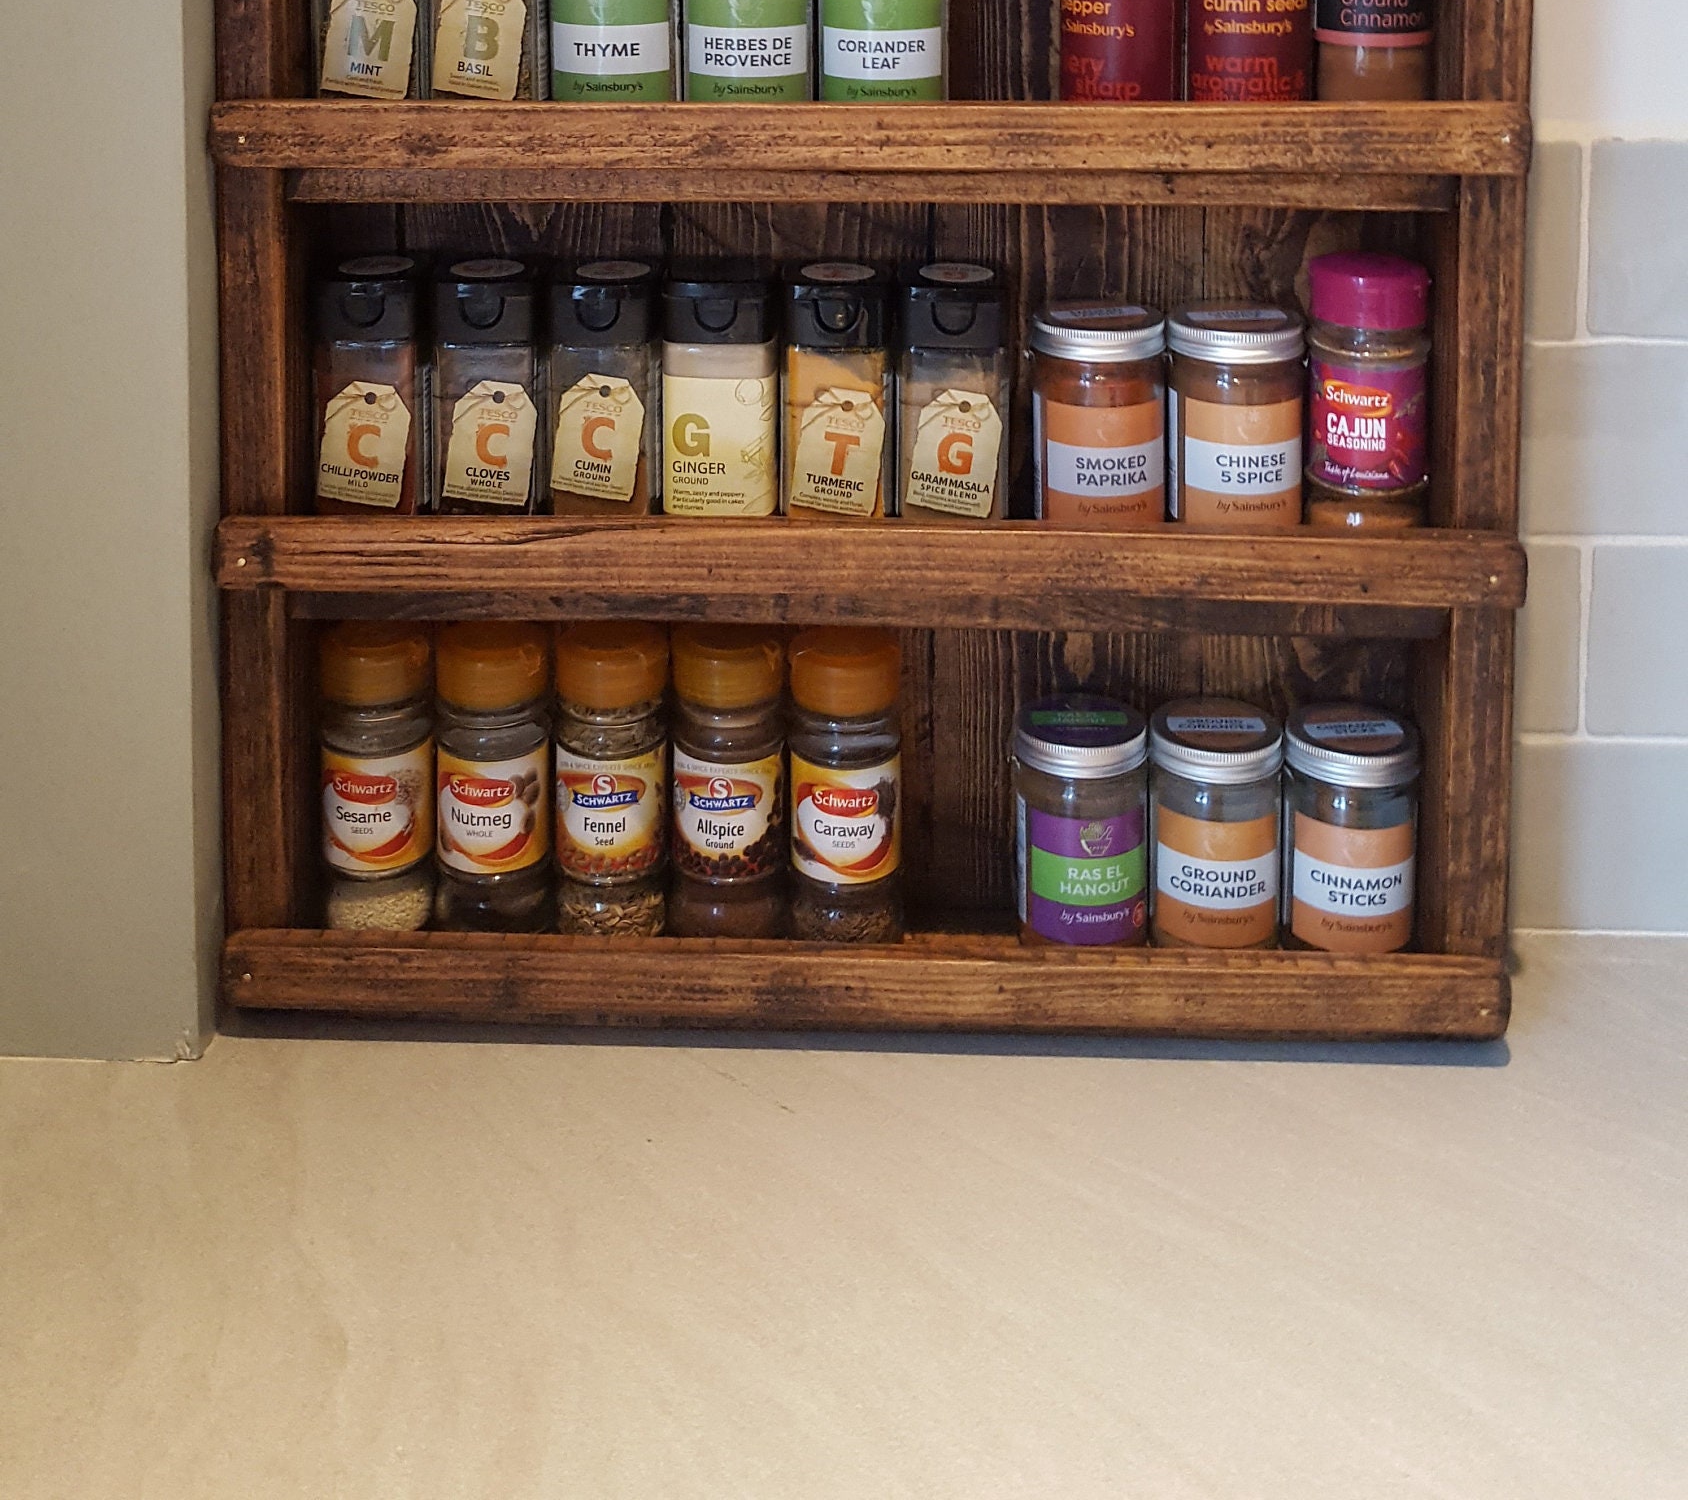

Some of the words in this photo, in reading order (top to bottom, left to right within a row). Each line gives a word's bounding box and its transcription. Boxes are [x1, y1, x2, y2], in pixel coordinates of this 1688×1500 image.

[355, 0, 395, 13] TESCO
[466, 0, 506, 13] TESCO
[1066, 19, 1135, 40] Sainsbury's
[1214, 19, 1293, 37] Sainsbury's
[347, 15, 395, 62] M
[464, 15, 499, 61] B
[704, 37, 767, 51] HERBES
[773, 37, 792, 50] DE
[837, 39, 926, 53] CORIANDER
[573, 42, 640, 57] THYME
[705, 52, 792, 67] PROVENCE
[862, 57, 901, 70] LEAF
[1066, 55, 1105, 80] ery
[1205, 55, 1277, 74] warm
[350, 62, 383, 77] MINT
[457, 61, 493, 77] BASIL
[586, 81, 644, 94] Sainsbury's
[713, 82, 726, 97] by
[726, 84, 784, 96] Sainsbury's
[860, 86, 917, 98] Sainsbury's
[1325, 385, 1389, 407] Schwartz
[350, 408, 389, 420] TESCO
[480, 408, 518, 420] TESCO
[584, 401, 623, 413] TESCO
[827, 415, 865, 429] TESCO
[943, 415, 981, 429] TESCO
[1326, 412, 1386, 439] CAJUN
[581, 417, 615, 463] C
[672, 413, 710, 457] G
[1327, 433, 1386, 452] SEASONING
[347, 424, 381, 469] C
[476, 423, 510, 469] C
[824, 431, 860, 476] T
[937, 432, 973, 476] G
[575, 460, 612, 474] CUMIN
[672, 460, 726, 475] GINGER
[1075, 455, 1147, 470] SMOKED
[1215, 452, 1286, 468] CHINESE
[321, 463, 353, 477] CHILLI
[354, 470, 399, 484] POWDER
[465, 467, 510, 481] CLOVES
[573, 470, 611, 483] GROUND
[672, 476, 709, 485] GROUND
[1076, 470, 1147, 486] PAPRIKA
[1221, 470, 1232, 483] 5
[1236, 468, 1283, 484] SPICE
[347, 479, 369, 488] MILD
[470, 478, 503, 489] WHOLE
[806, 473, 864, 492] TURMERIC
[911, 471, 948, 486] GARAM
[949, 478, 990, 494] MASALA
[814, 486, 852, 498] GROUND
[920, 483, 945, 495] SPICE
[948, 488, 977, 500] BLEND
[1092, 500, 1147, 514] Sainsbury's
[1216, 500, 1231, 513] by
[1231, 499, 1287, 511] Sainsbury's
[334, 777, 394, 796] Schwartz
[452, 780, 510, 798] Schwartz
[596, 776, 612, 795] S
[712, 779, 727, 799] S
[577, 793, 633, 806] SCHWARTZ
[694, 796, 749, 809] SCHWARTZ
[814, 791, 873, 808] Schwartz
[336, 806, 392, 824] Sesame
[451, 806, 512, 829] Nutmeg
[350, 826, 374, 835] SEEDS
[584, 817, 626, 833] Fennel
[697, 818, 745, 840] Allspice
[814, 820, 875, 839] Caraway
[466, 829, 494, 838] WHOLE
[595, 836, 615, 846] Seed
[705, 838, 734, 850] Ground
[831, 840, 856, 849] SEEDS
[1068, 867, 1102, 881] RAS
[1107, 865, 1124, 878] EL
[1181, 865, 1257, 883] GROUND
[1310, 869, 1402, 891] CINNAMON
[1060, 877, 1130, 896] HANOUT
[1170, 876, 1266, 898] CORIANDER
[1328, 891, 1387, 906] STICKS
[1060, 909, 1075, 925] by
[1075, 908, 1130, 924] Sainsbury's
[1197, 912, 1255, 925] Sainsbury's
[1336, 920, 1393, 933] Sainsbury's
